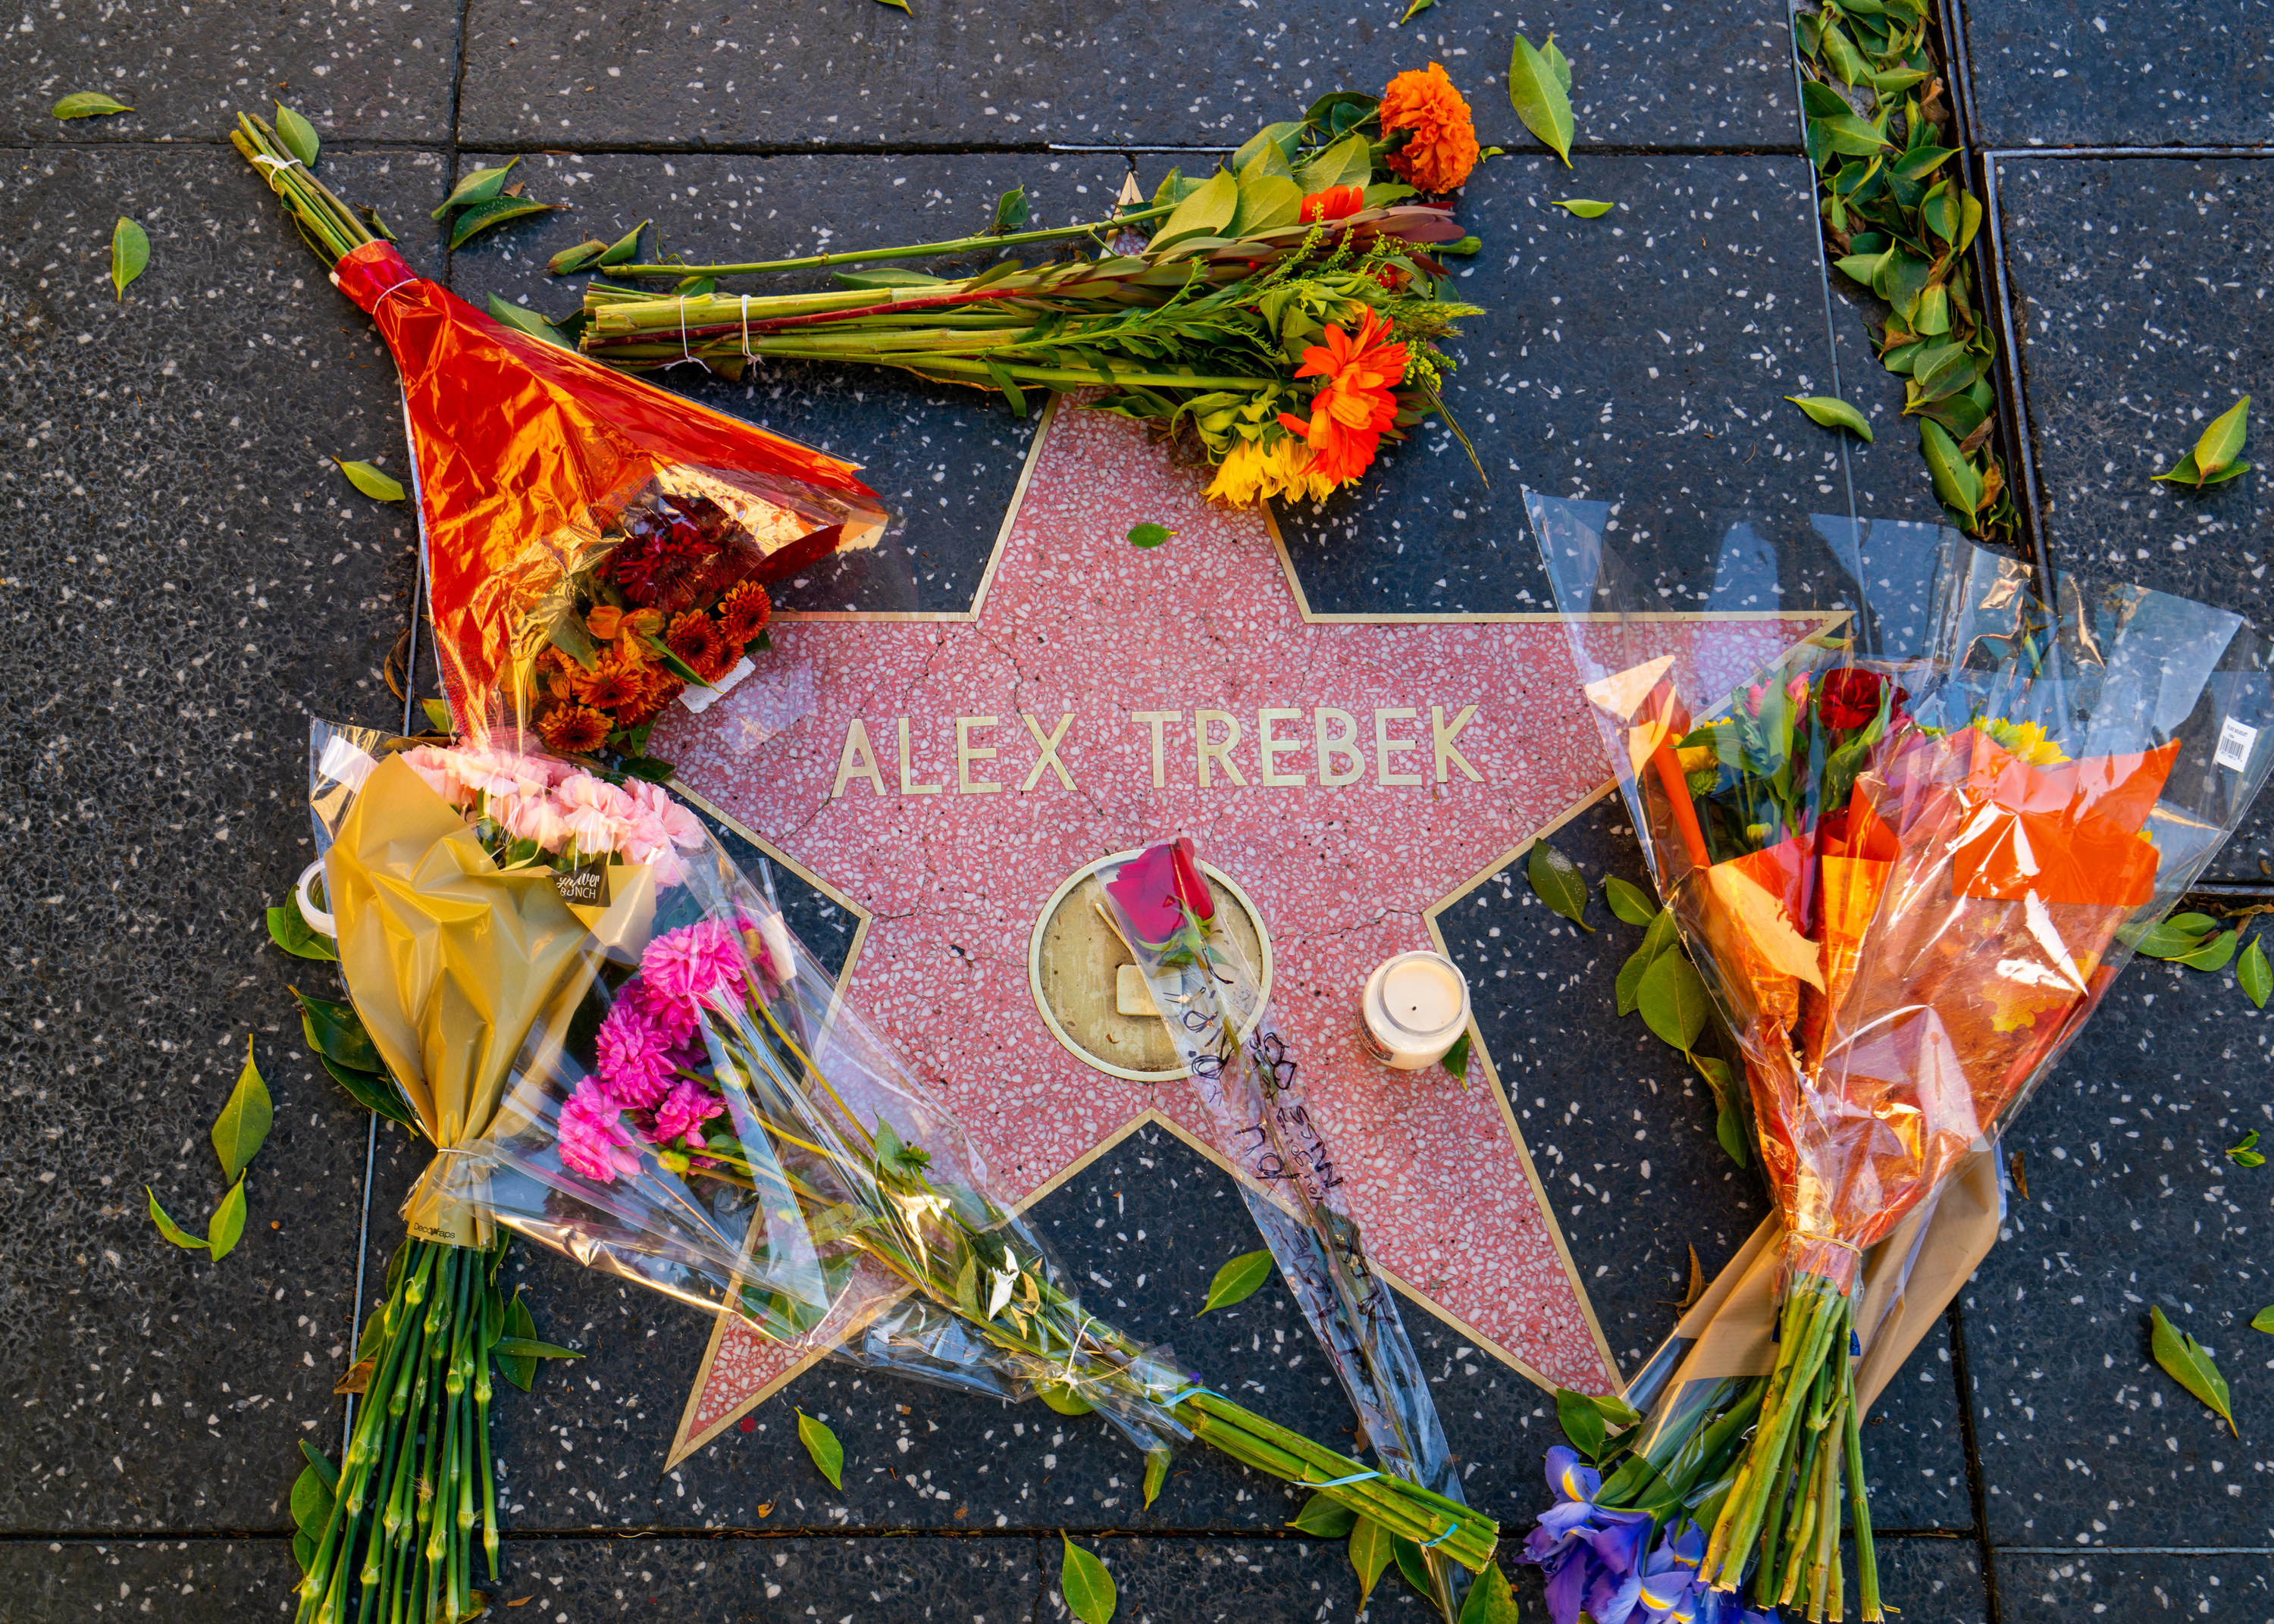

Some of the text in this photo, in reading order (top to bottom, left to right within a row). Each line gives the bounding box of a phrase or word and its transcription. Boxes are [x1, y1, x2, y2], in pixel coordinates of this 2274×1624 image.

[831, 705, 1486, 798] ALEX TREBEK
[559, 886, 597, 900] BUNCH
[1276, 1107, 1313, 1167] going
